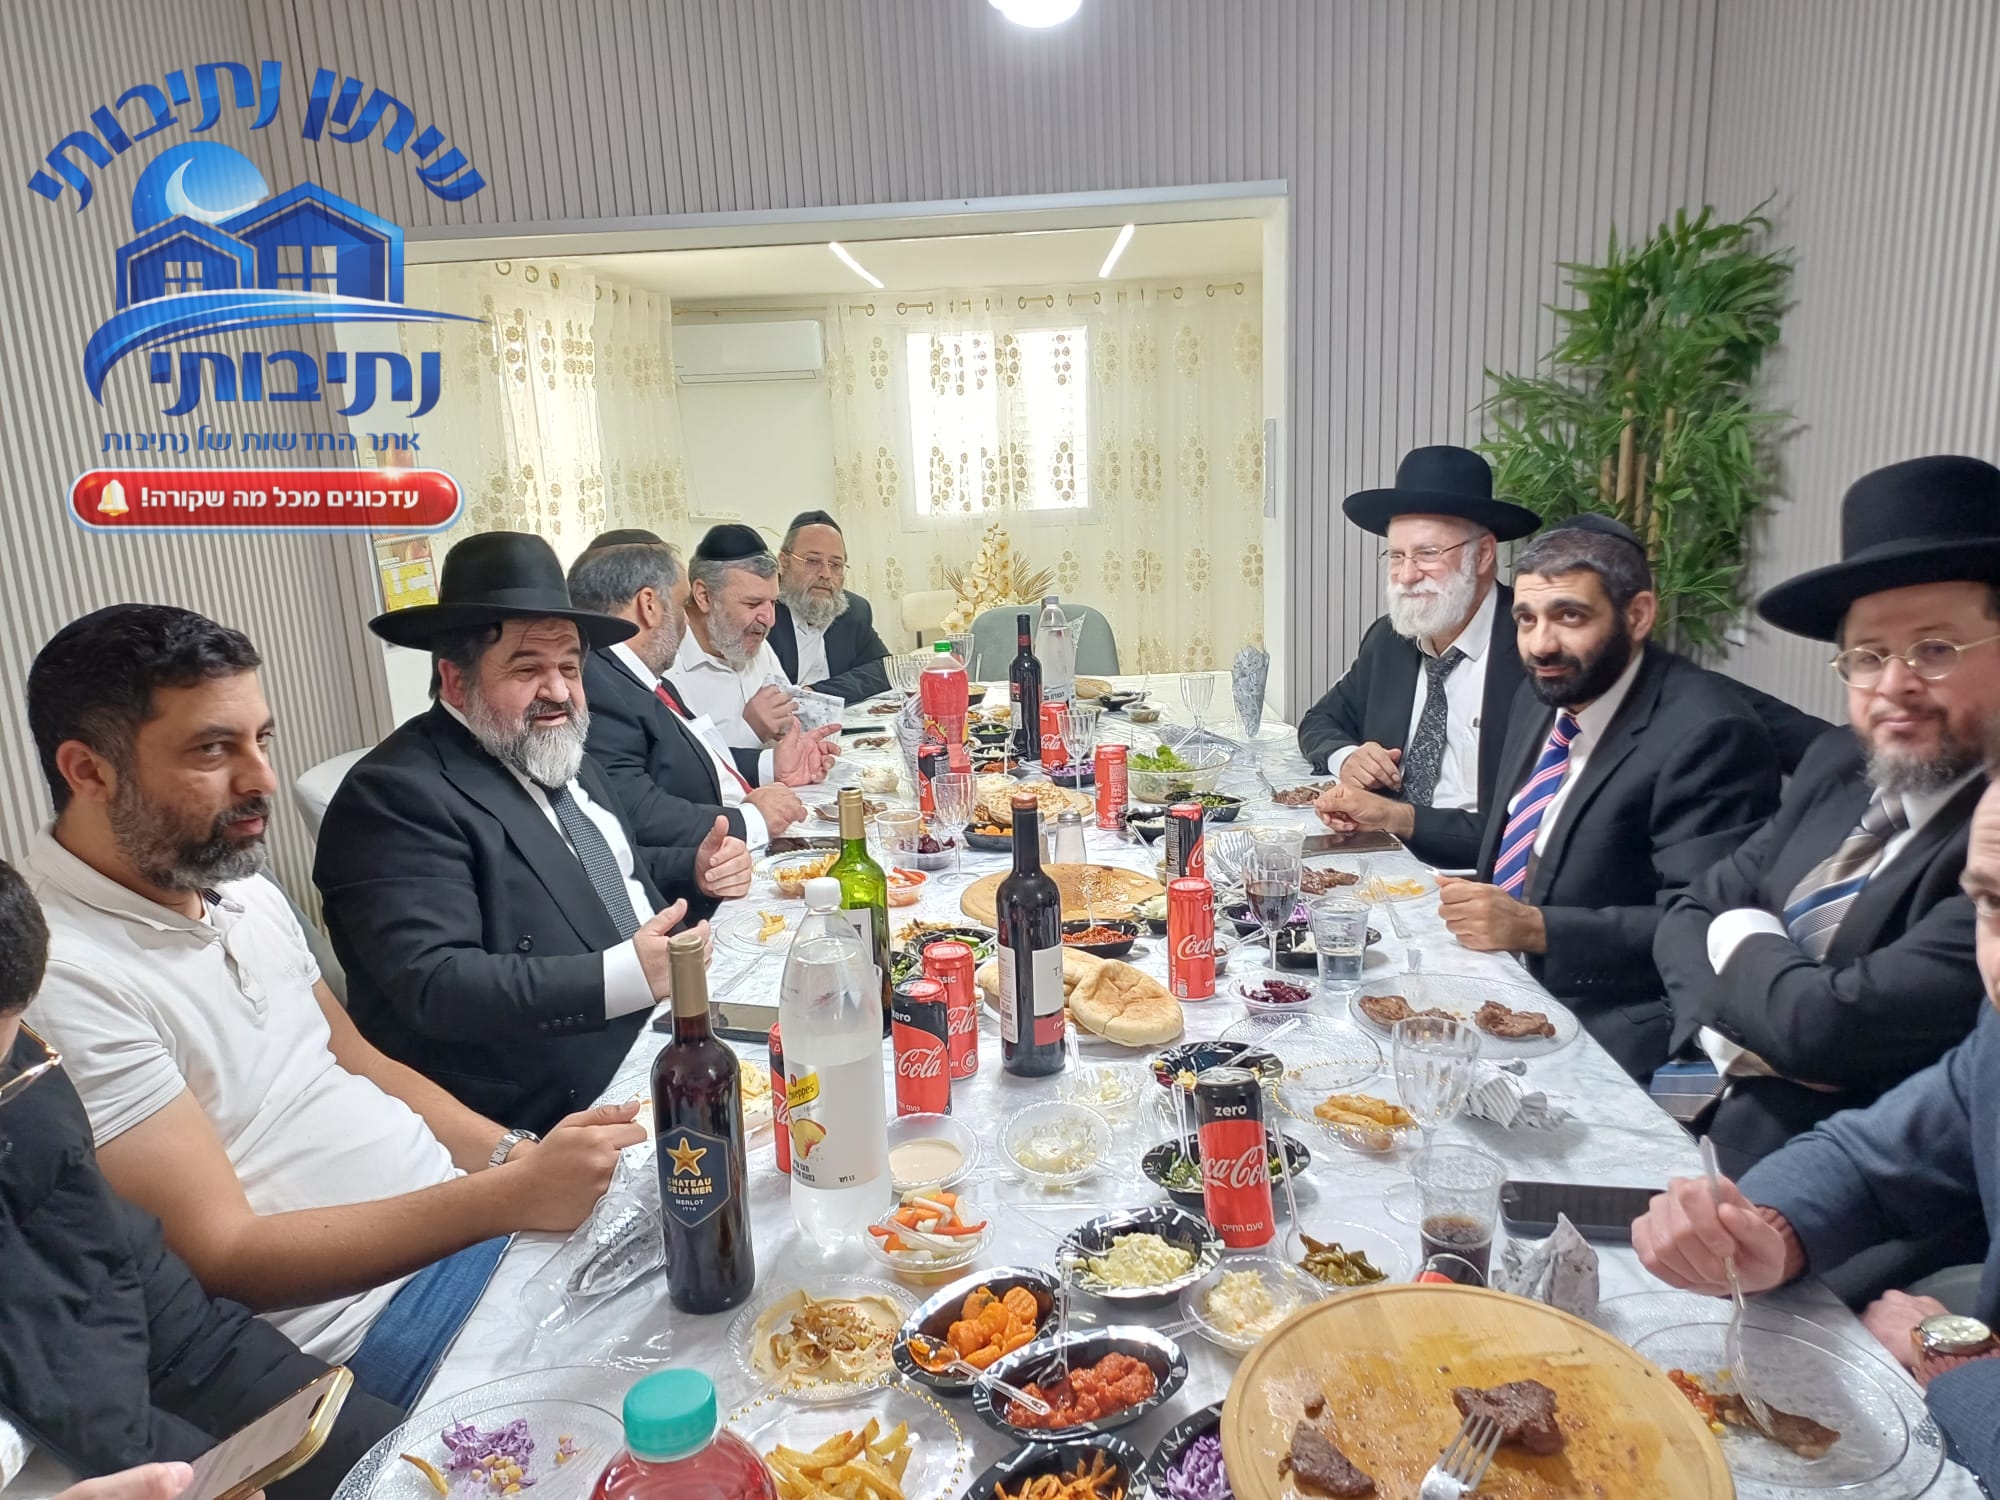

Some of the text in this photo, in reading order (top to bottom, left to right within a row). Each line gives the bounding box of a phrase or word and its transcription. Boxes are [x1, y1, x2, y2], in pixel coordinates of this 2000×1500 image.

[1214, 1105, 1247, 1117] zero
[667, 1177, 712, 1187] CHATEAU
[679, 1187, 690, 1195] LA
[691, 1186, 713, 1195] MER
[1222, 1221, 1263, 1232] טעם החיים
